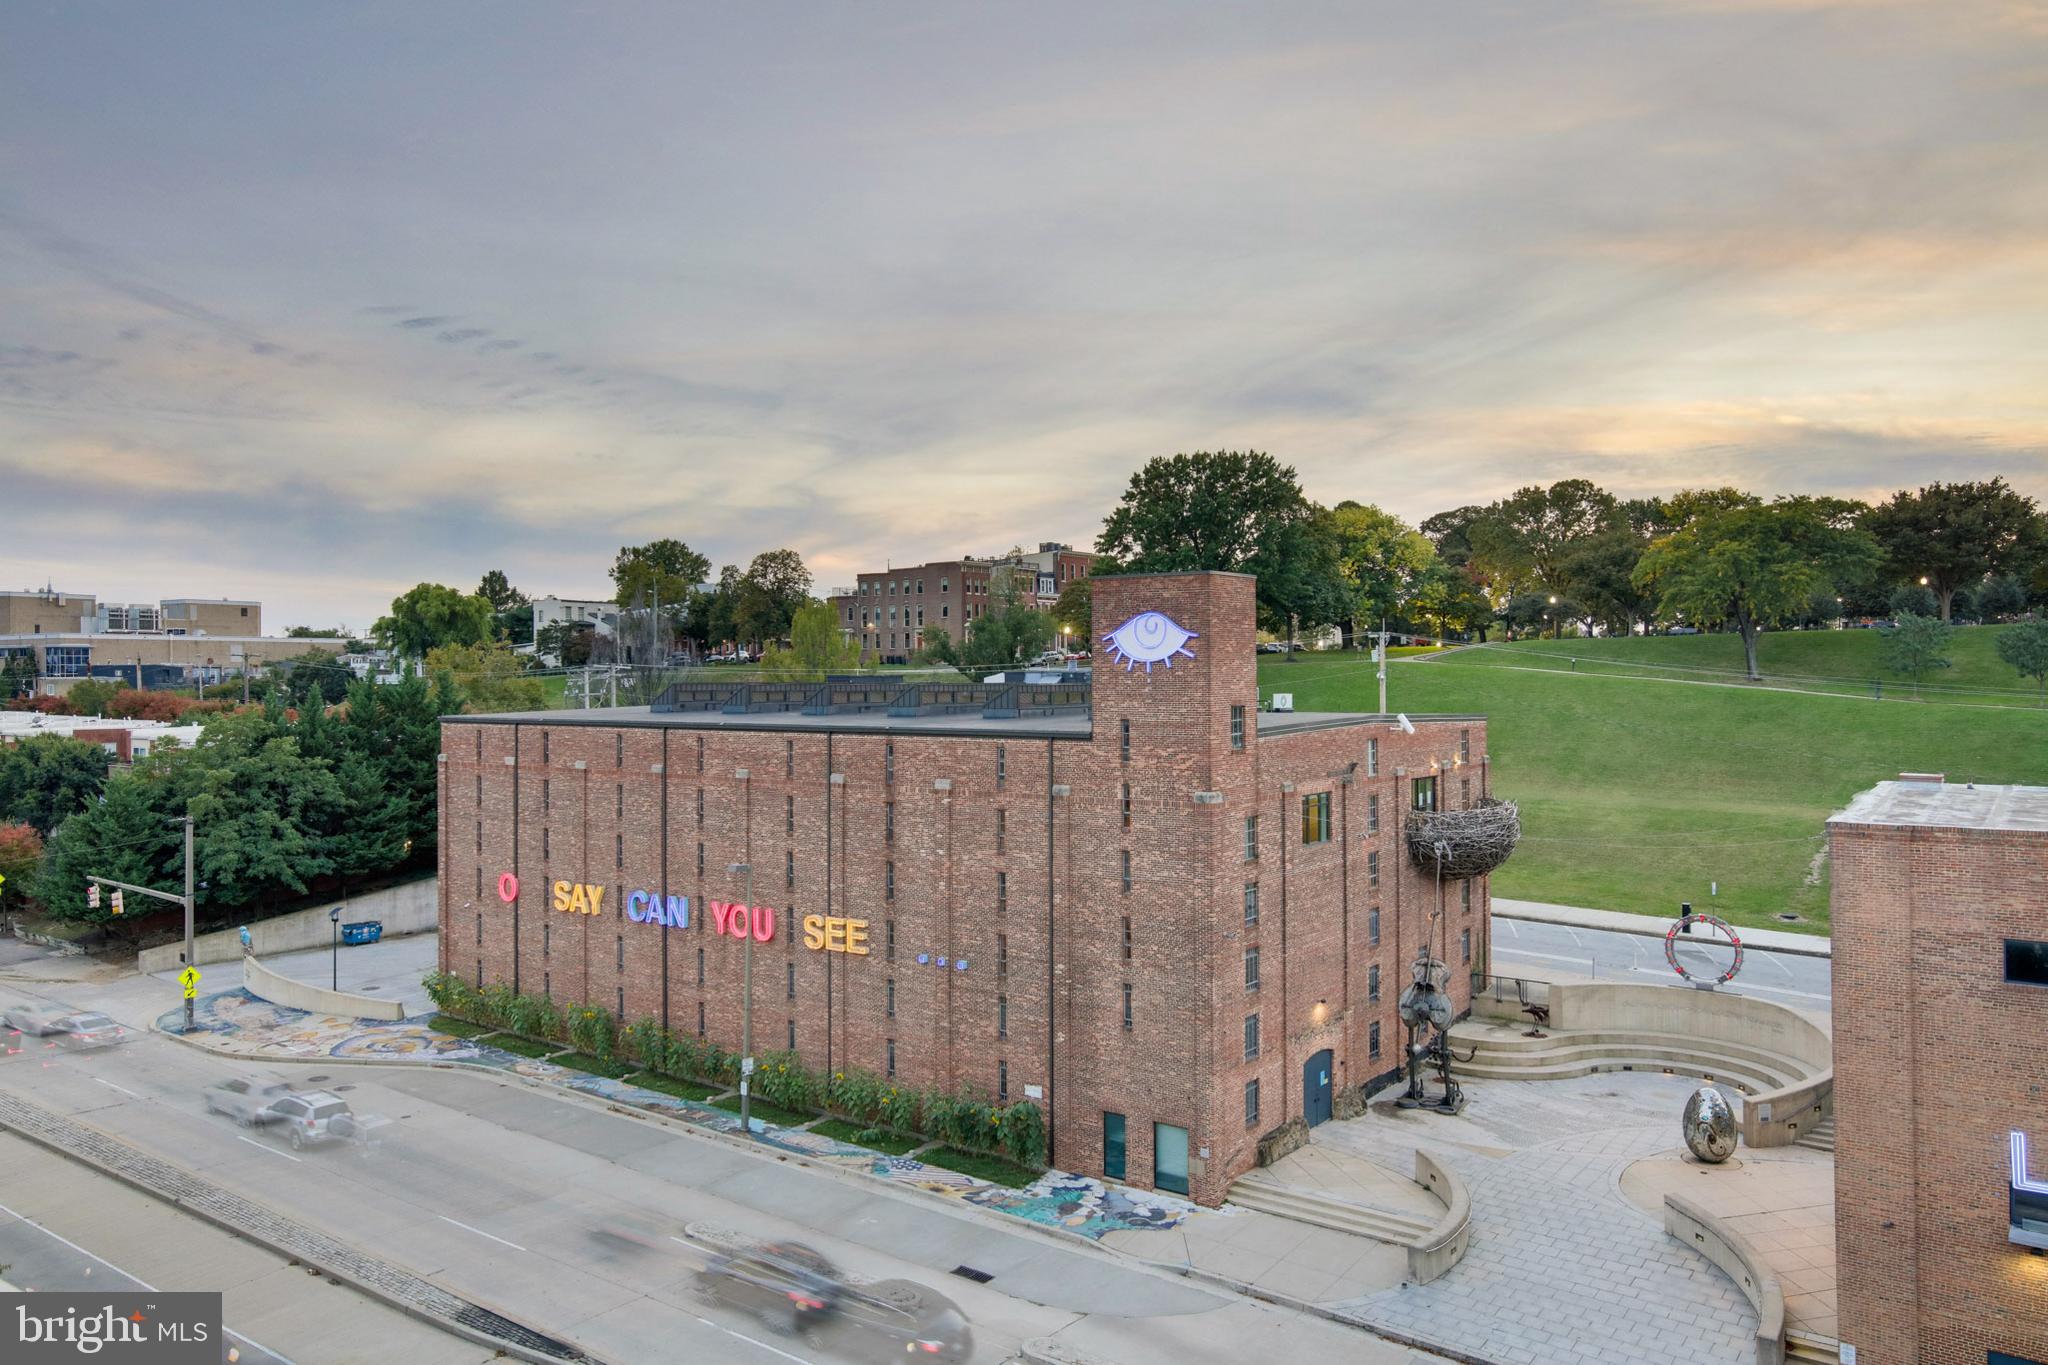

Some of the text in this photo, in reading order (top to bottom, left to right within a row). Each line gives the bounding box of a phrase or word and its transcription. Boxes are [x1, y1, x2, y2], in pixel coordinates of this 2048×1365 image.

[498, 872, 520, 903] O
[553, 880, 604, 916] SAY
[627, 889, 689, 928] CAN
[711, 901, 775, 942] YOU
[803, 914, 870, 955] SEE
